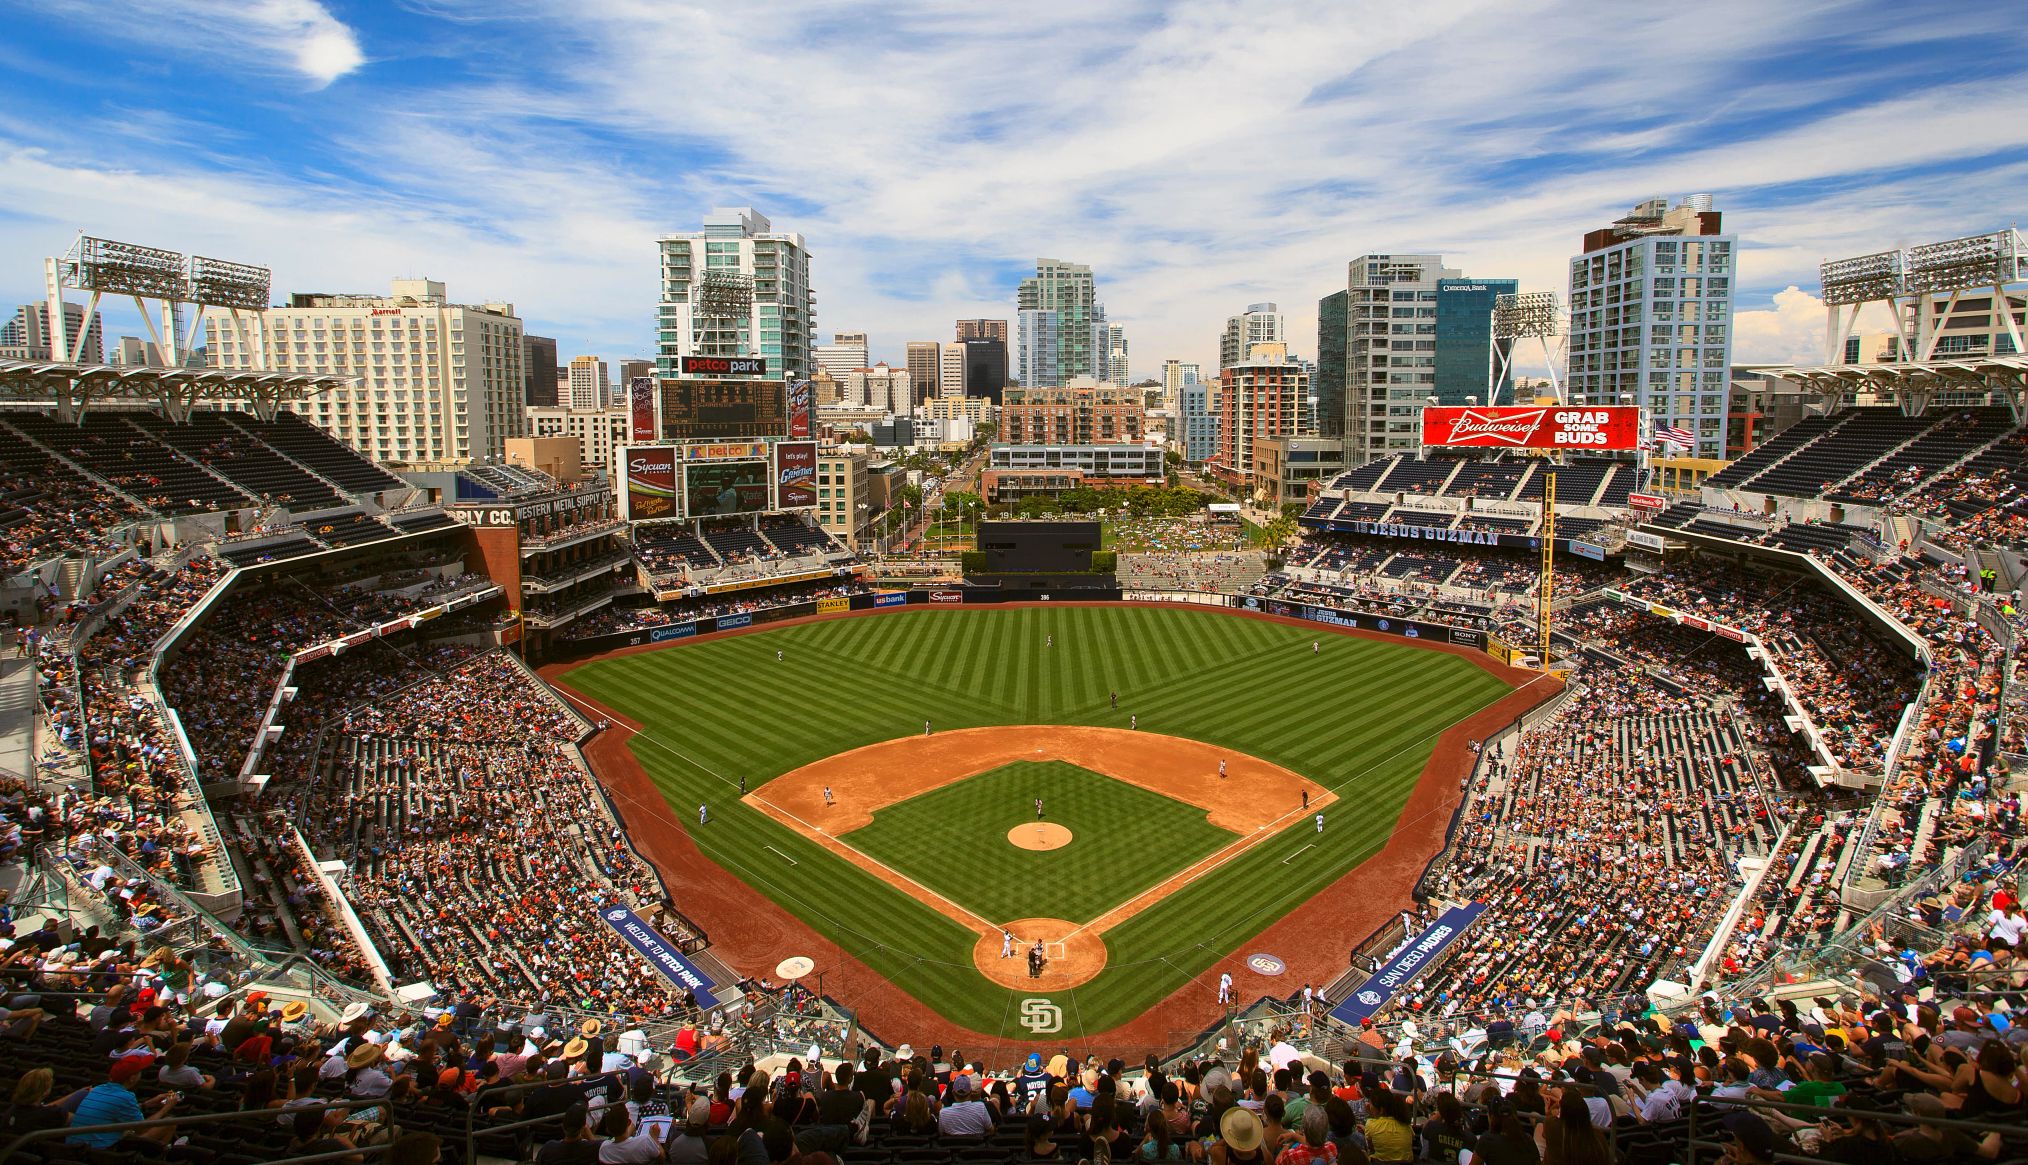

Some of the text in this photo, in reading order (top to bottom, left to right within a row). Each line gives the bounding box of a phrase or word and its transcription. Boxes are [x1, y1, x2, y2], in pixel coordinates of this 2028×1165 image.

[372, 308, 401, 316] Marriott
[688, 358, 759, 373] petco park
[1554, 412, 1610, 424] GRAB
[1449, 418, 1540, 434] Budweiser
[1564, 424, 1598, 432] SOME
[1554, 432, 1608, 444] BUDS
[708, 446, 742, 456] petco
[630, 458, 672, 475] Sycuan
[516, 490, 612, 520] WESTERN METAL SUPPLY CO.
[490, 510, 515, 525] CO.
[1370, 523, 1420, 539] JESUS
[1422, 527, 1499, 546] GUZMAN
[817, 599, 849, 609] STANLEY
[1302, 606, 1337, 620] 15 JESUS
[718, 616, 750, 628] GEICO
[1316, 615, 1357, 628] GUZMAN
[351, 634, 370, 645] TOYOTA
[652, 626, 694, 641] QUALCOMM
[1454, 631, 1477, 639] SONY
[1723, 630, 1742, 640] TOYOTA
[630, 637, 640, 645] 357
[306, 648, 328, 660] TOYOTA
[624, 922, 704, 989] WELCOME TO PETCO PARK
[1379, 925, 1453, 987] SAN DIEGO PADRES
[1020, 998, 1062, 1034] SD
[1026, 1080, 1046, 1090] MAYBIN
